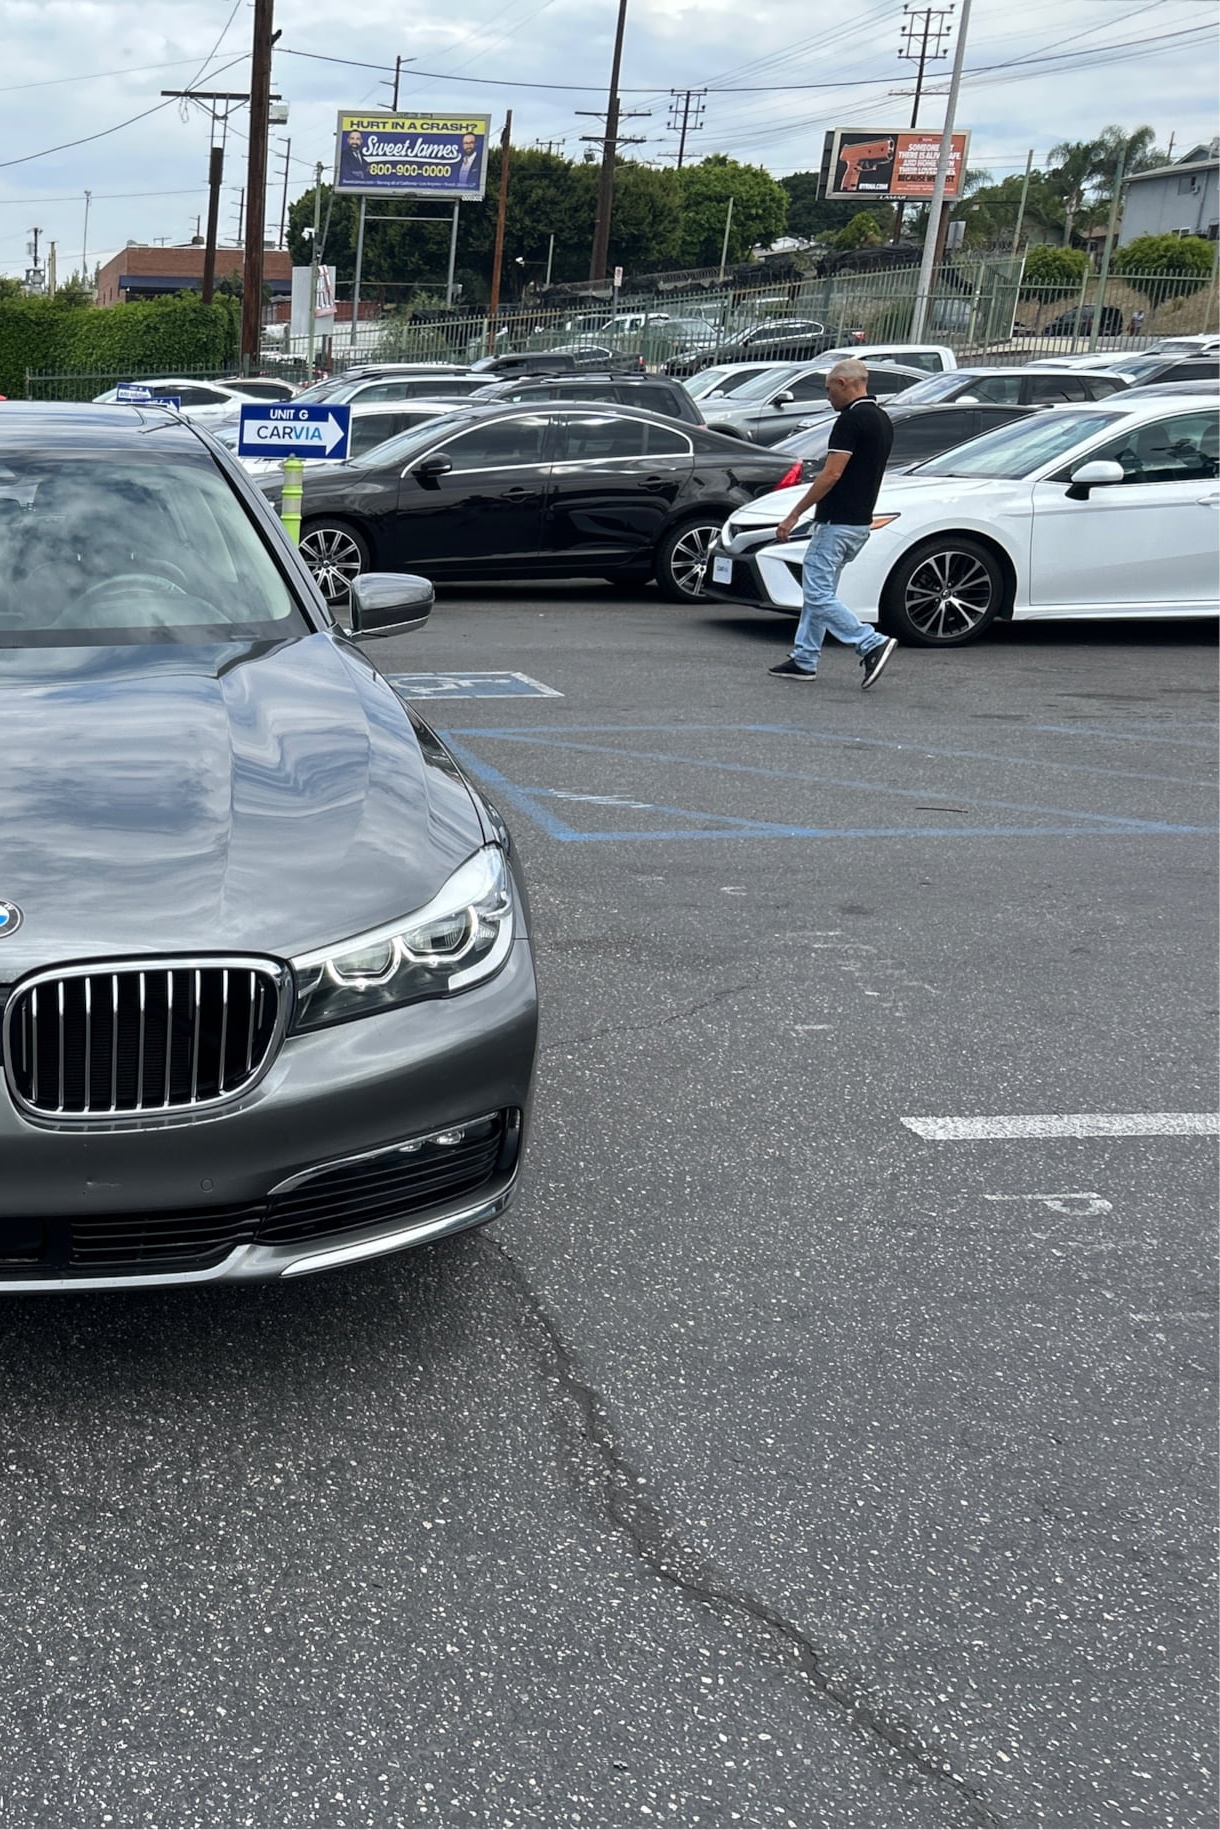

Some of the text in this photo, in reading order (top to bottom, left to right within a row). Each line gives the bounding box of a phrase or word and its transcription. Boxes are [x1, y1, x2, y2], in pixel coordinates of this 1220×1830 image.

[350, 120, 478, 131] HURT IN A CRASH?
[369, 163, 451, 177] 800-900-0000
[269, 409, 309, 420] UNIT G
[257, 425, 323, 441] CARVIA
